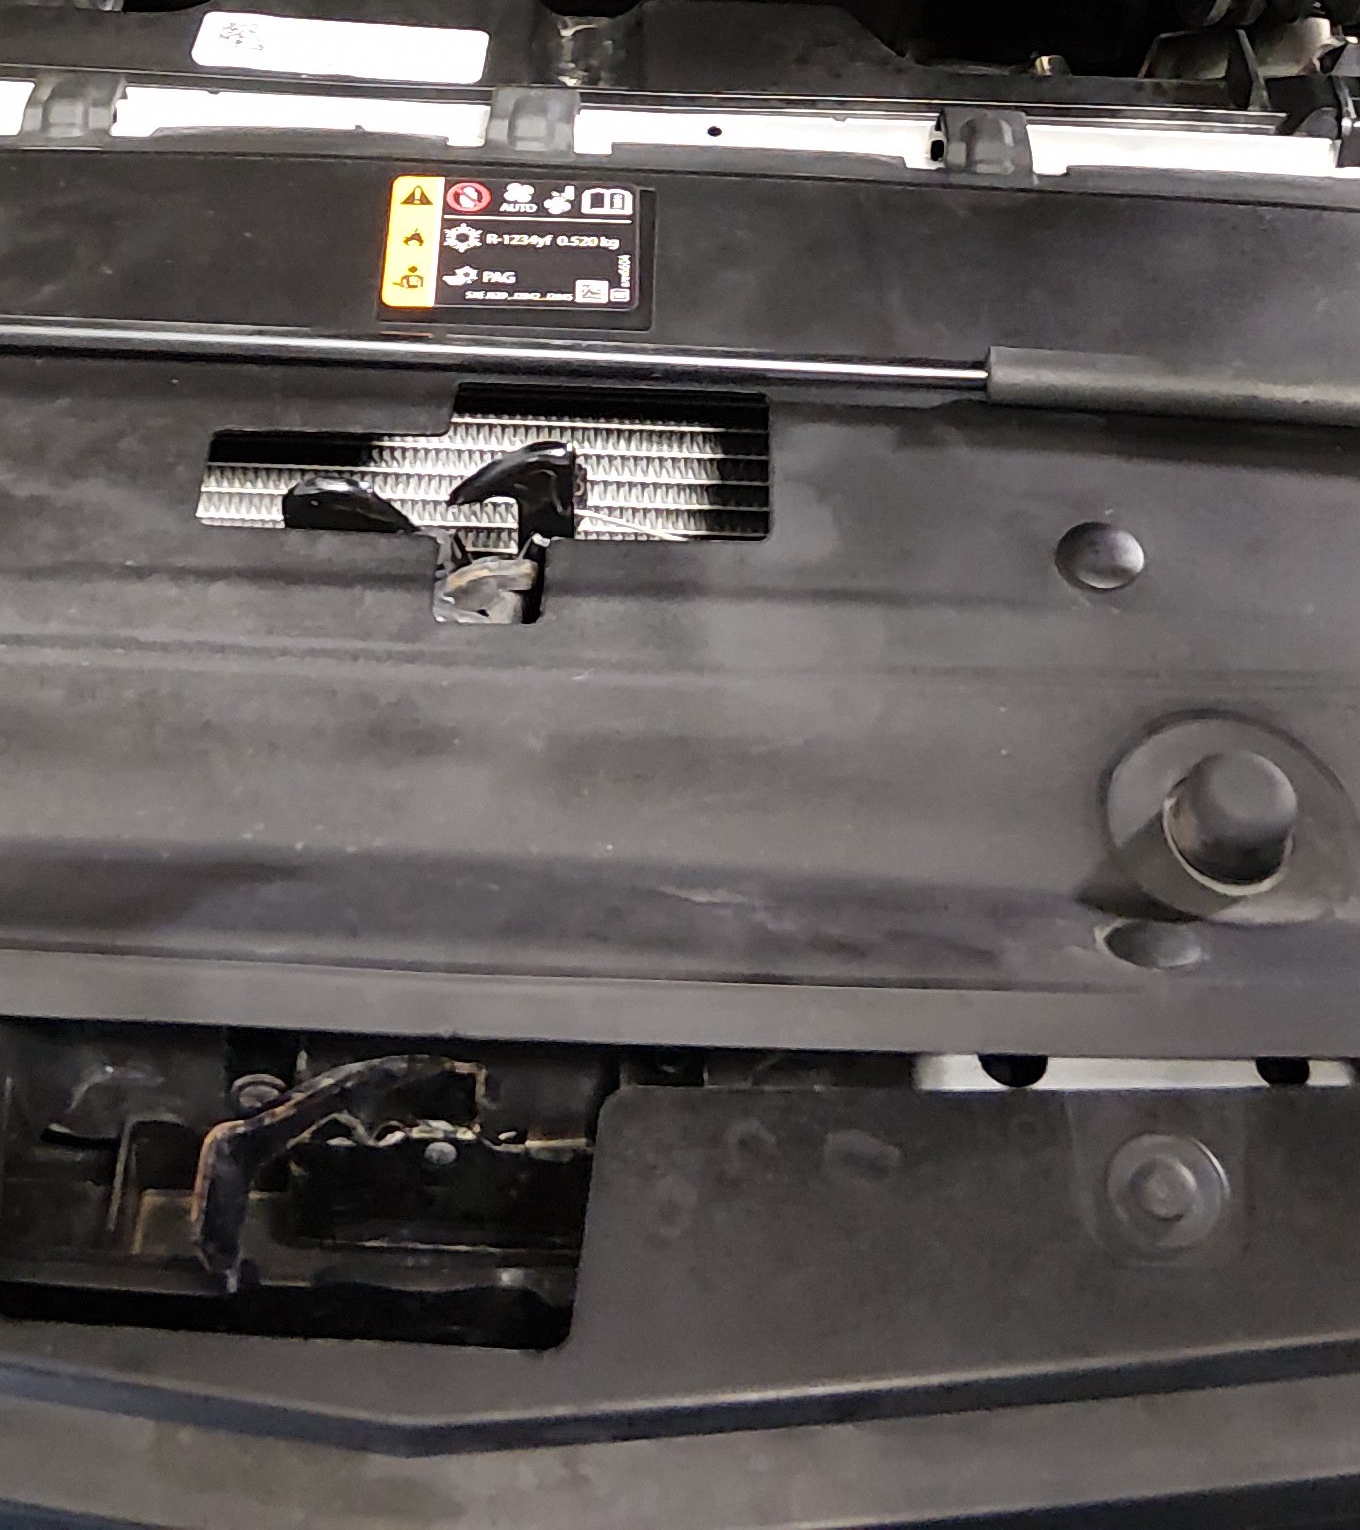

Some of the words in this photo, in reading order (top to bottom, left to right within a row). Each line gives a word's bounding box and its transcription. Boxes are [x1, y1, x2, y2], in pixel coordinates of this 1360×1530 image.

[499, 203, 538, 213] AUTO
[486, 233, 554, 248] R-1234yf
[556, 235, 598, 247] 0.520
[600, 236, 620, 250] kg
[482, 271, 516, 284] PAG
